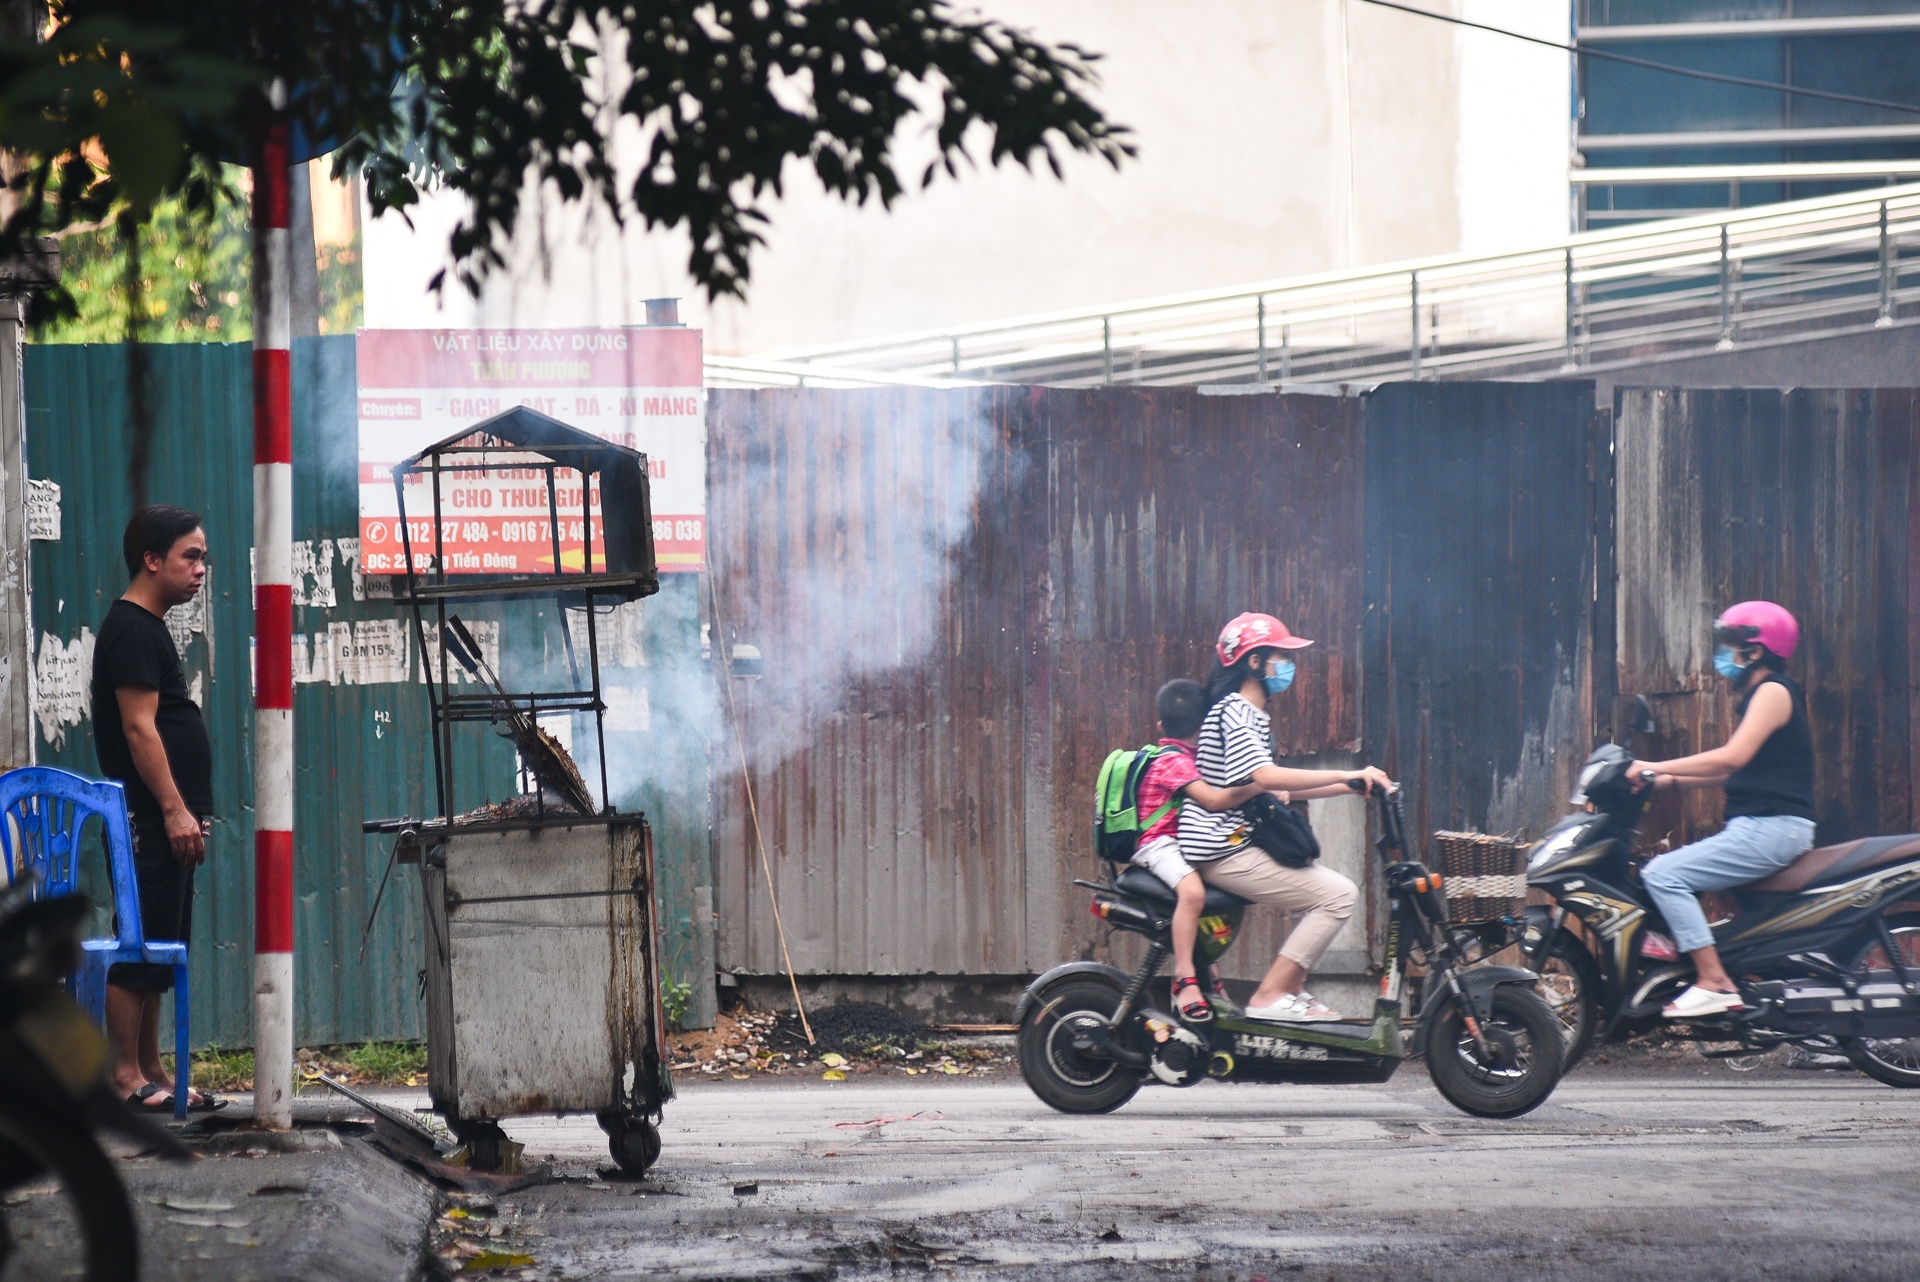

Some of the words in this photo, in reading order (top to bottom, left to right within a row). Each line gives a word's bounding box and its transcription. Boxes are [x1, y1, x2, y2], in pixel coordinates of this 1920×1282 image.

[433, 332, 470, 354] VẬT
[477, 331, 520, 354] LIỆU
[527, 332, 565, 350] XÂY
[572, 333, 627, 354] DỰNG
[452, 488, 492, 508] CHO
[500, 485, 548, 508] THUÊ
[433, 521, 459, 543] 27
[462, 521, 489, 543] 484
[501, 521, 537, 543] 0916
[675, 520, 702, 541] 038
[371, 643, 395, 657] 15%
[375, 710, 391, 723] H2
